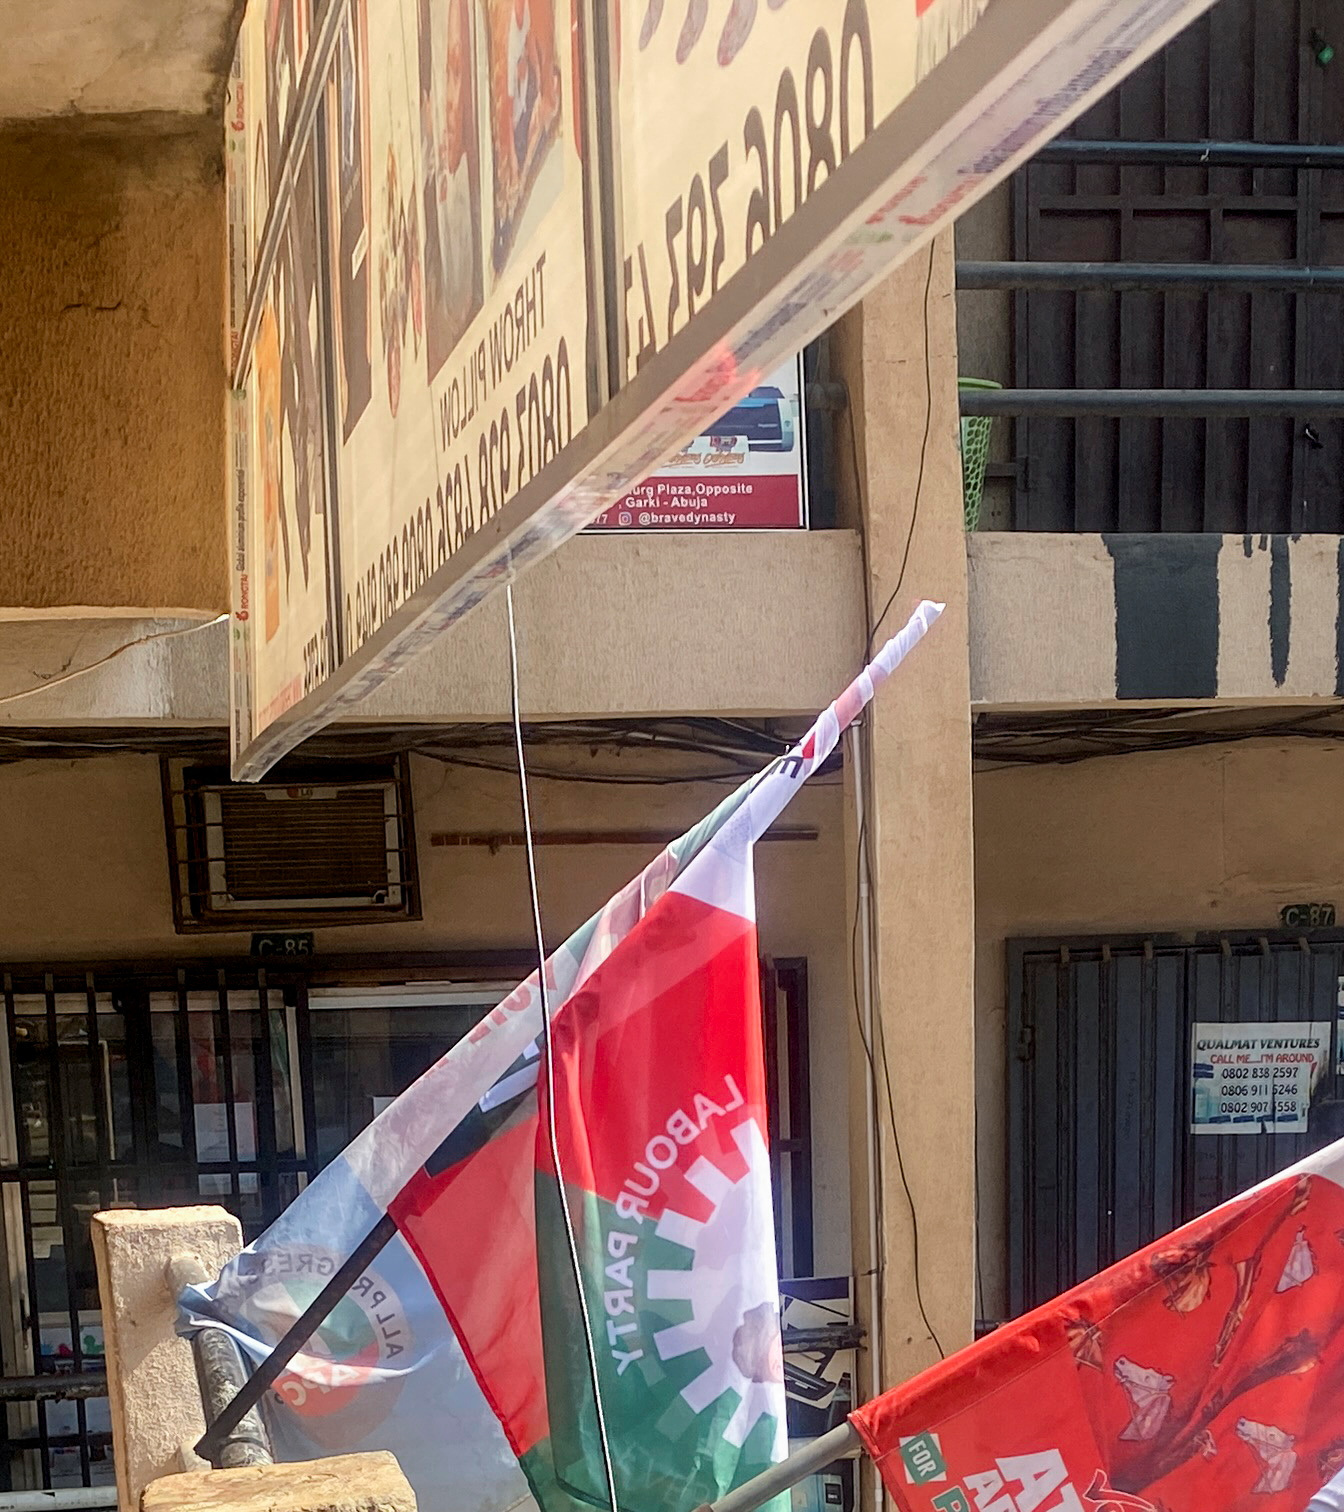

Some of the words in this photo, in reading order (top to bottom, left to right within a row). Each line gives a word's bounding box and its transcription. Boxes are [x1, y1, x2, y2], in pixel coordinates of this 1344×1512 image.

[625, 497, 660, 509] Garki
[671, 497, 708, 509] Abuja
[639, 512, 736, 525] @bravedynasty
[1284, 905, 1335, 926] C-87
[258, 939, 309, 956] C-85
[1197, 1039, 1258, 1051] QUALMAT
[1260, 1038, 1320, 1050] VENTURES
[1211, 1054, 1234, 1064] CALL
[1275, 1053, 1315, 1063] AROUND
[1222, 1068, 1249, 1079] 0802
[1251, 1067, 1270, 1079] 838
[1272, 1067, 1299, 1078] 2597
[1221, 1085, 1249, 1096] 0806
[1251, 1085, 1269, 1096] 911
[1220, 1102, 1248, 1113] 0802
[1250, 1102, 1268, 1112] 907
[909, 1440, 937, 1477] FOR
